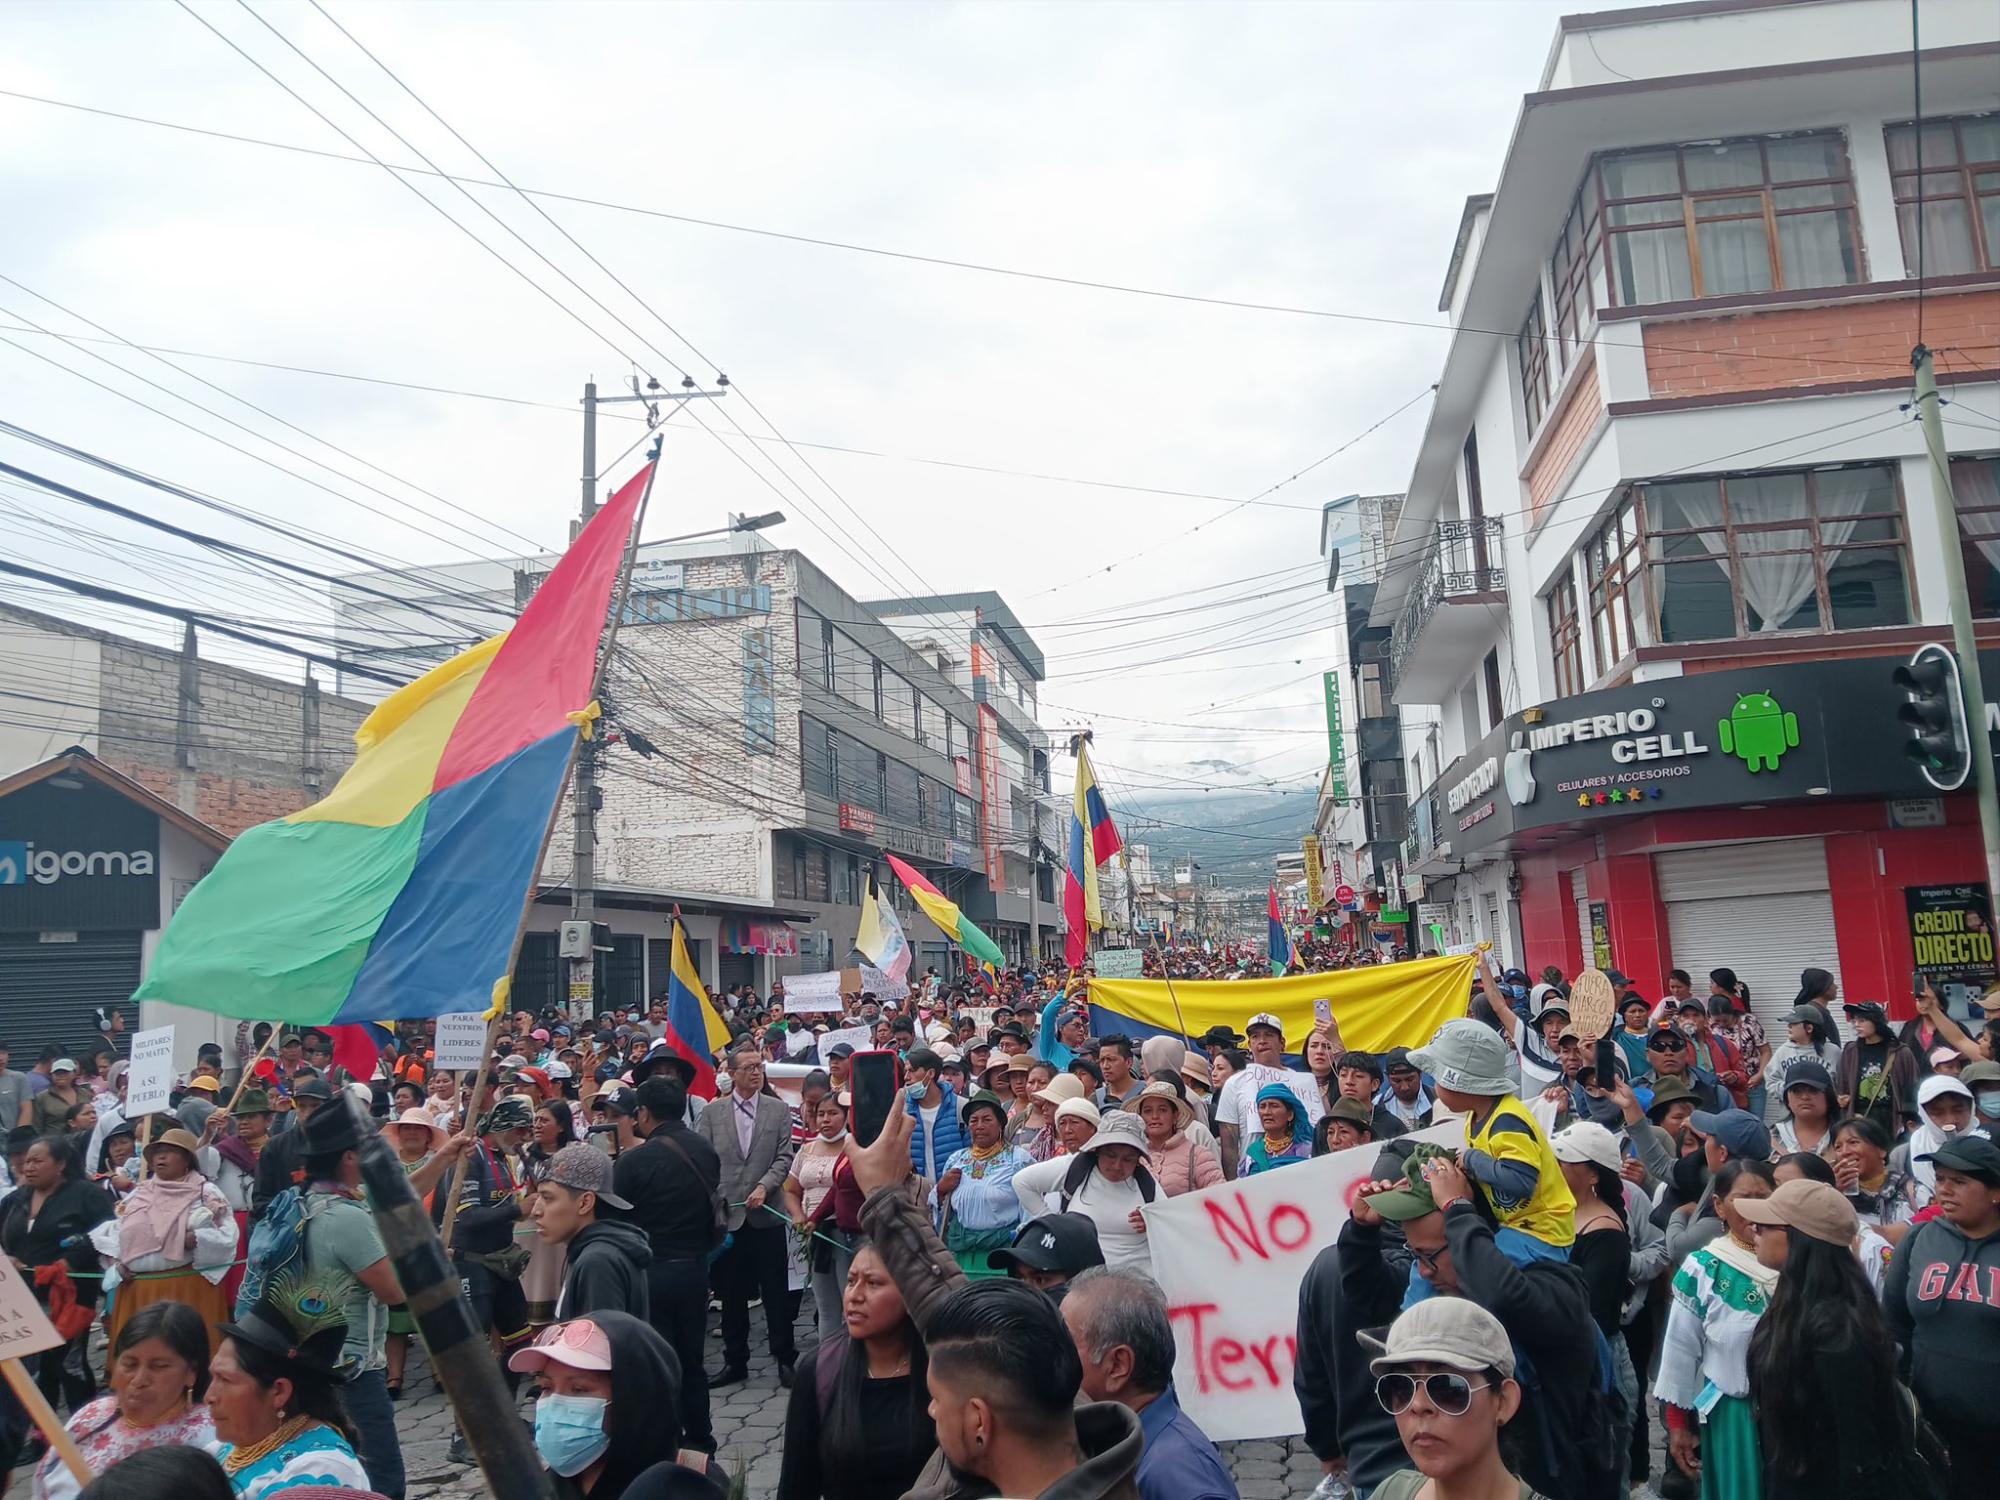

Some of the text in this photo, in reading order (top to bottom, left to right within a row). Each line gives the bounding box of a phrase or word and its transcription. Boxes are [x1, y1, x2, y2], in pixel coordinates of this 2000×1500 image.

[1530, 708, 1656, 751] IMPERIO
[1611, 731, 1709, 763] CELL
[1557, 765, 1691, 793] CELULARES Y ACCESORIOS
[26, 841, 153, 884] igoma
[1920, 887, 1972, 898] Imperio Cell
[1914, 932, 1993, 965] DIRECTO
[1576, 975, 1609, 996] FUERA
[1572, 994, 1607, 1015] NARCO
[441, 1023, 483, 1031] NUESTROS
[135, 1035, 173, 1049] MILITARES
[134, 1047, 171, 1060] NO MATEN
[132, 1088, 166, 1103] PUEBLO
[1204, 1190, 1313, 1262] No
